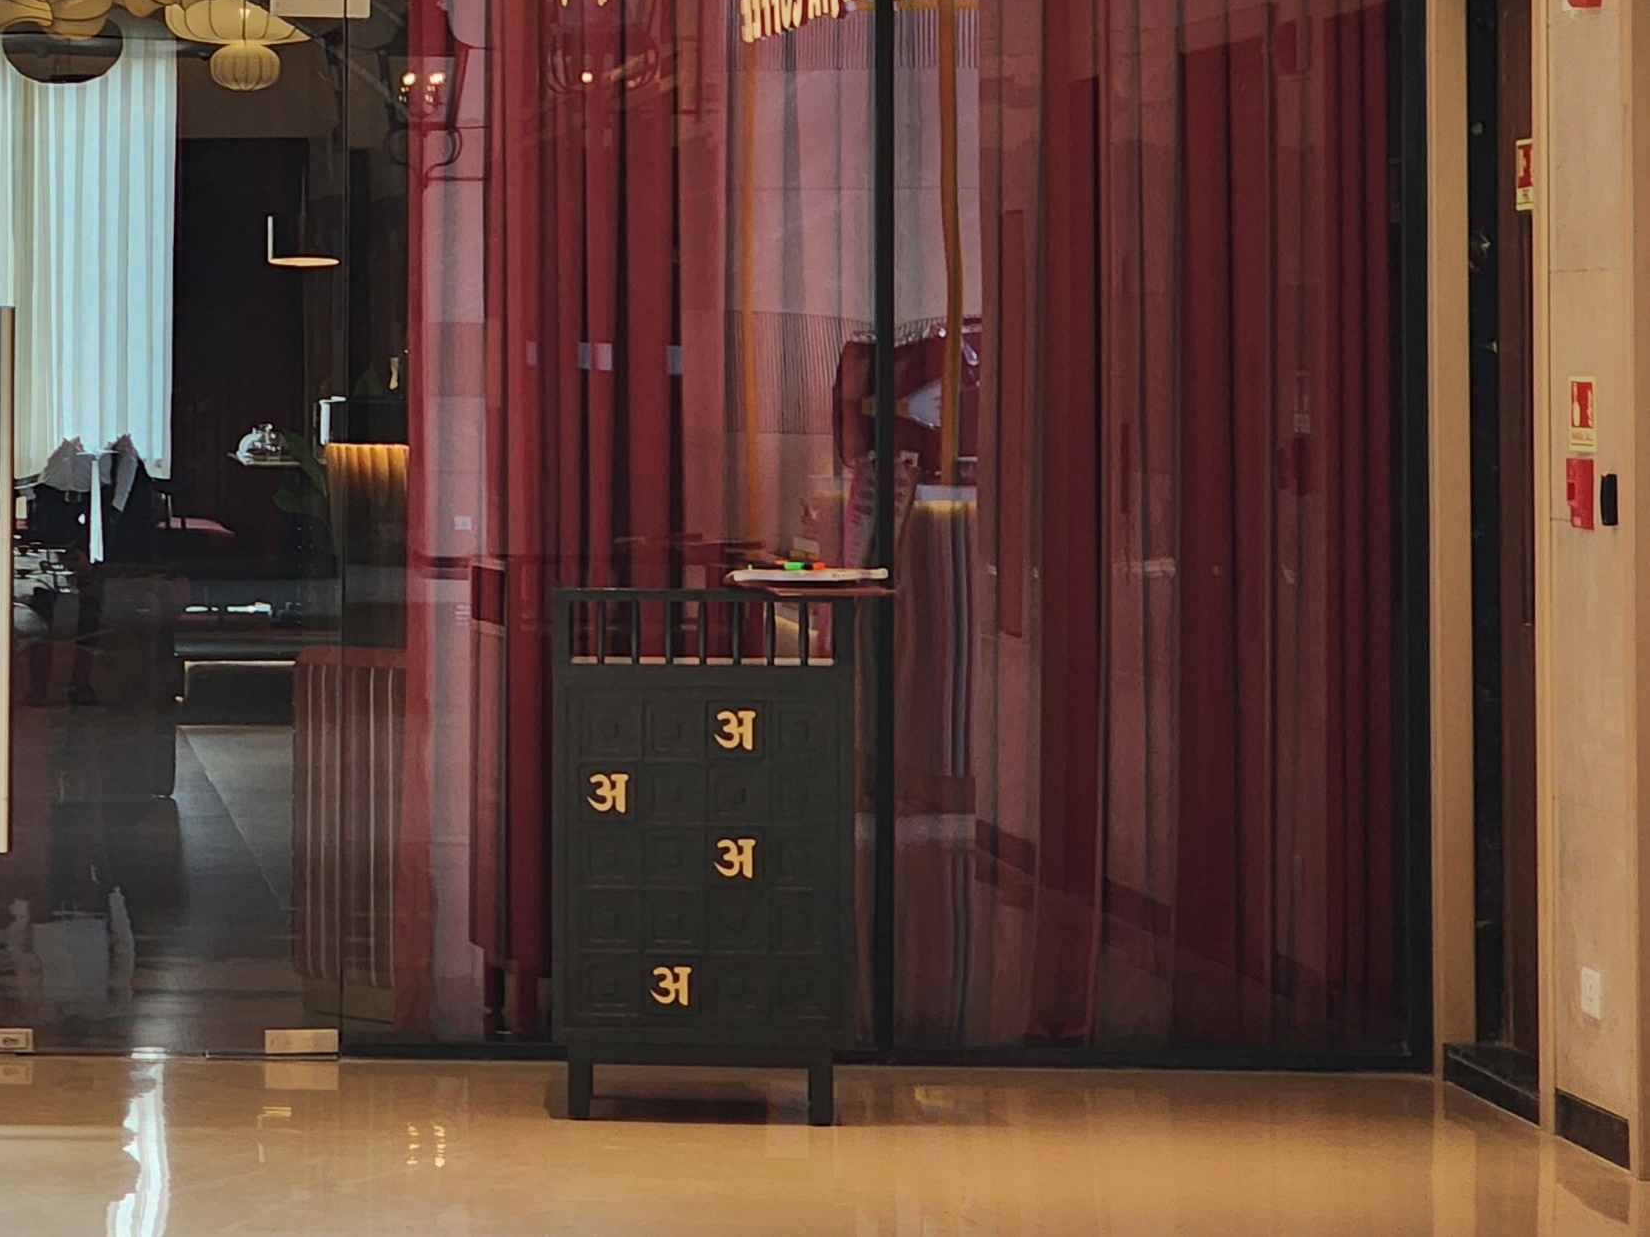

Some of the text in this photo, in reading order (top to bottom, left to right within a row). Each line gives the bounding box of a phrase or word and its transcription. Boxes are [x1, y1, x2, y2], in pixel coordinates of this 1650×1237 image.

[713, 709, 757, 752] अ
[586, 772, 630, 815] अ
[713, 837, 757, 881] अ
[649, 965, 693, 1008] अ
